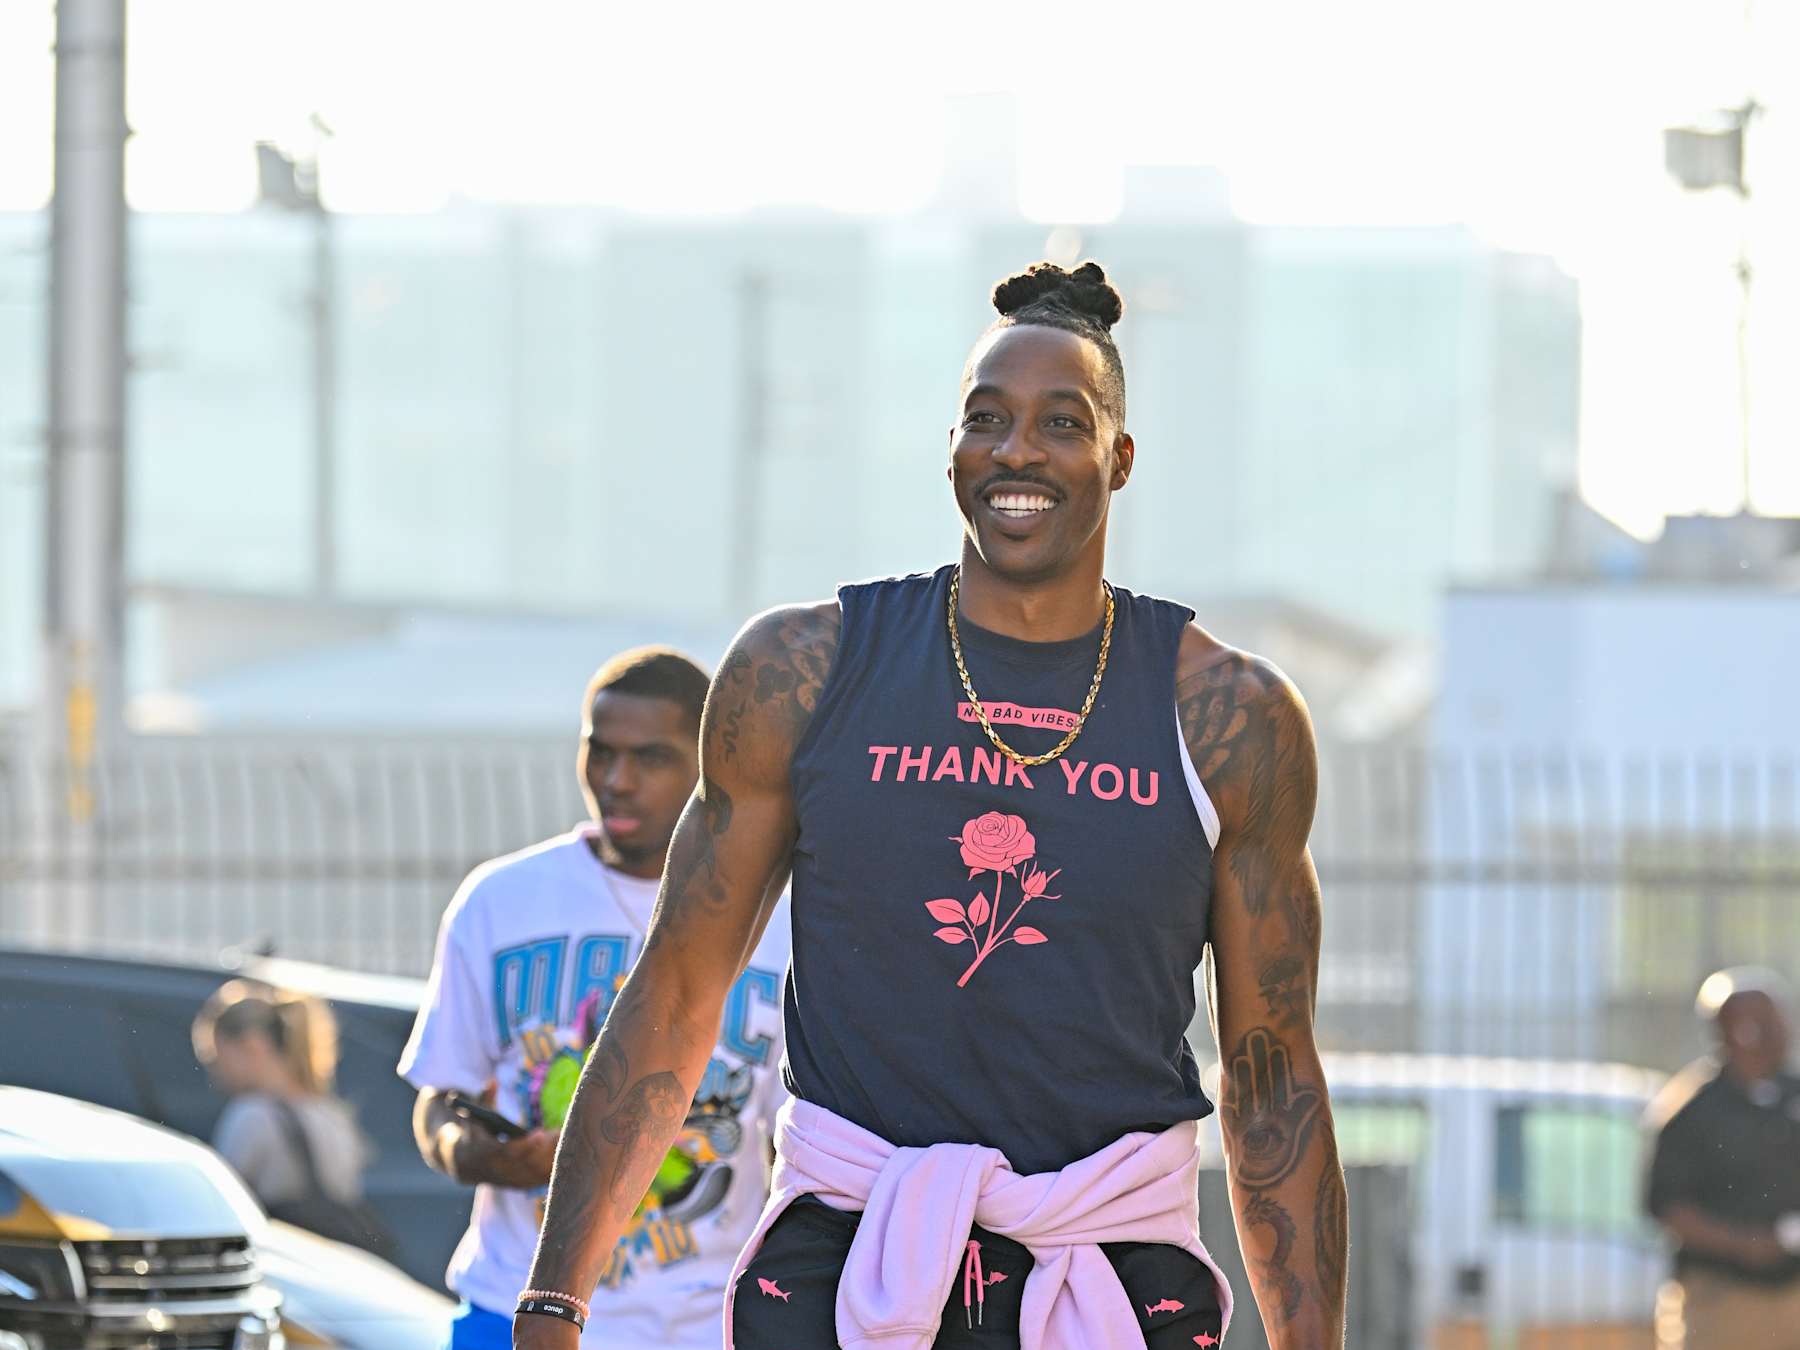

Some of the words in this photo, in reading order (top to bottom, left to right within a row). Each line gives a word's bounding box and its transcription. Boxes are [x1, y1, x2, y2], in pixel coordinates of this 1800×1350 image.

[992, 707, 1023, 719] BAD
[1031, 713, 1074, 728] VIBES
[868, 745, 1035, 790] THANK
[1059, 758, 1160, 807] YOU
[492, 934, 780, 1067] MAC
[543, 1304, 564, 1315] deuce
